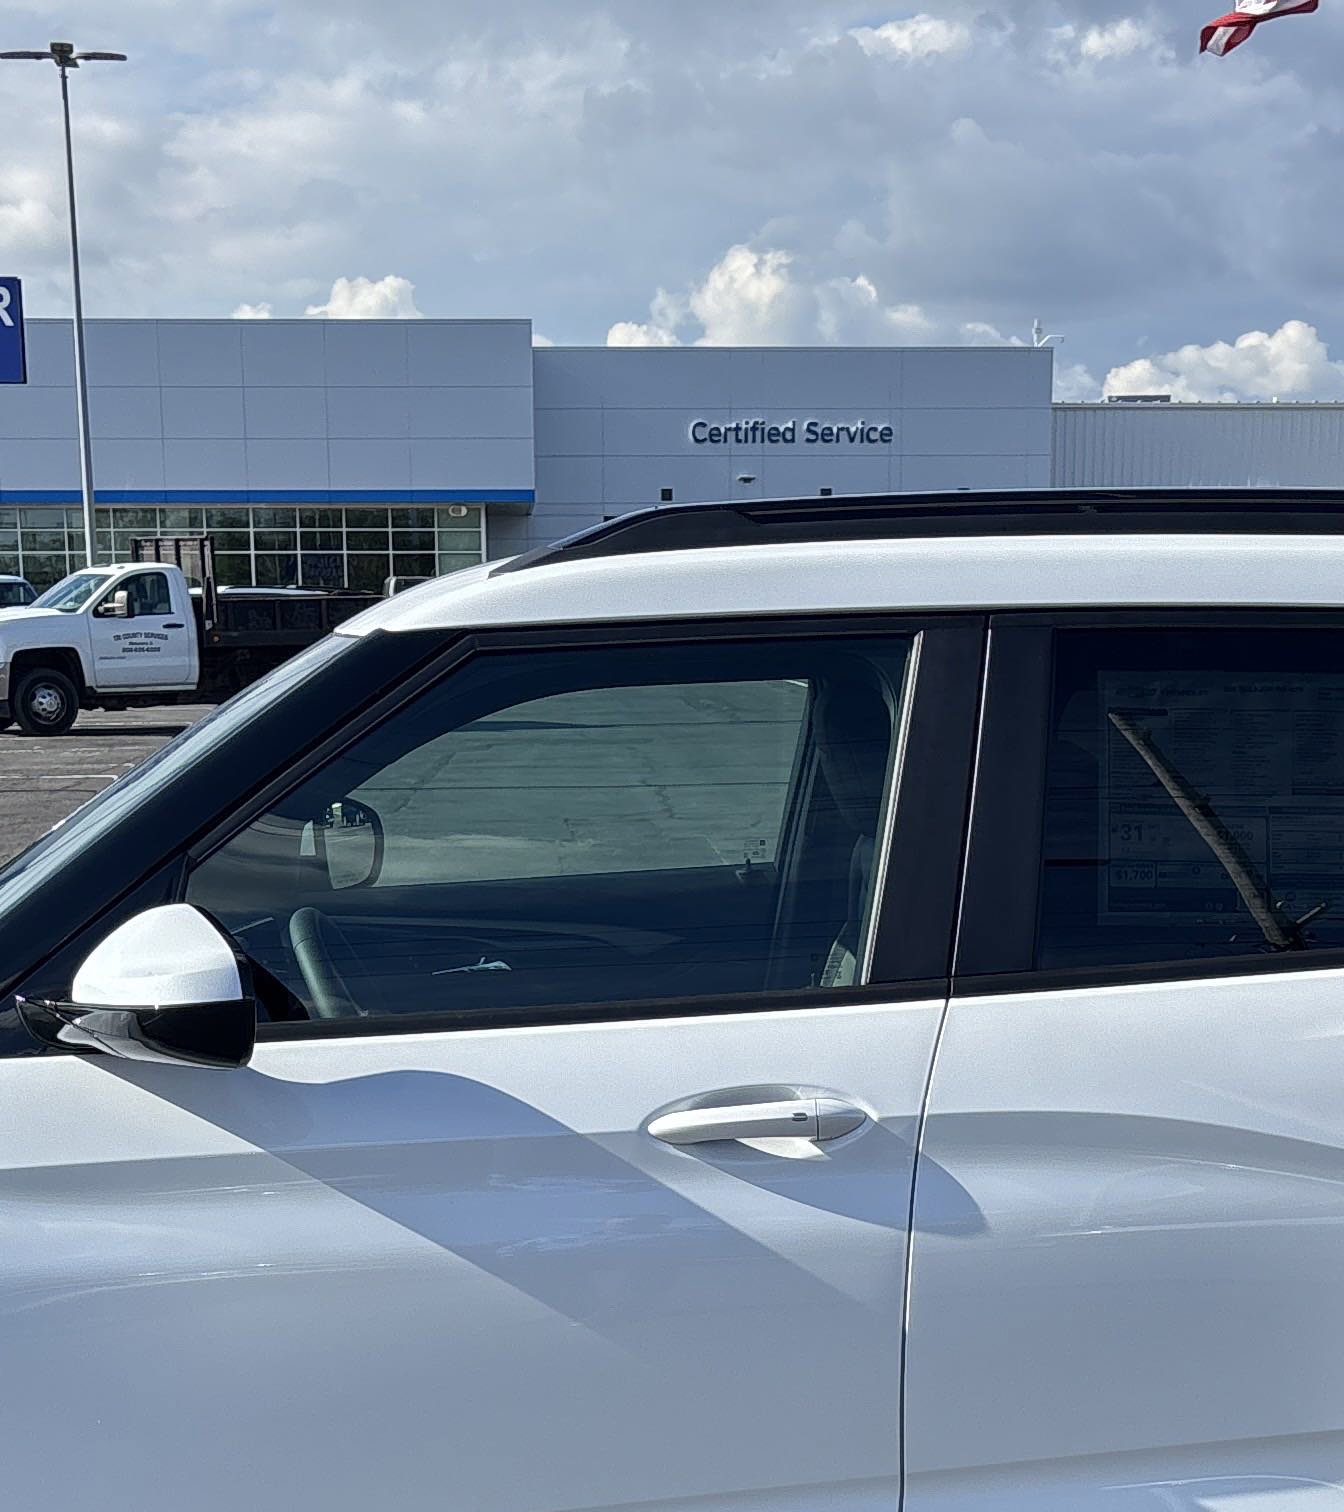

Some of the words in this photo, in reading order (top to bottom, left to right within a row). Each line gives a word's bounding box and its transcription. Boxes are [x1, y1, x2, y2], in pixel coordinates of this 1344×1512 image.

[690, 419, 796, 444] Certified
[804, 420, 893, 444] Service
[1120, 823, 1143, 841] 31
[1115, 869, 1154, 882] $1,700
